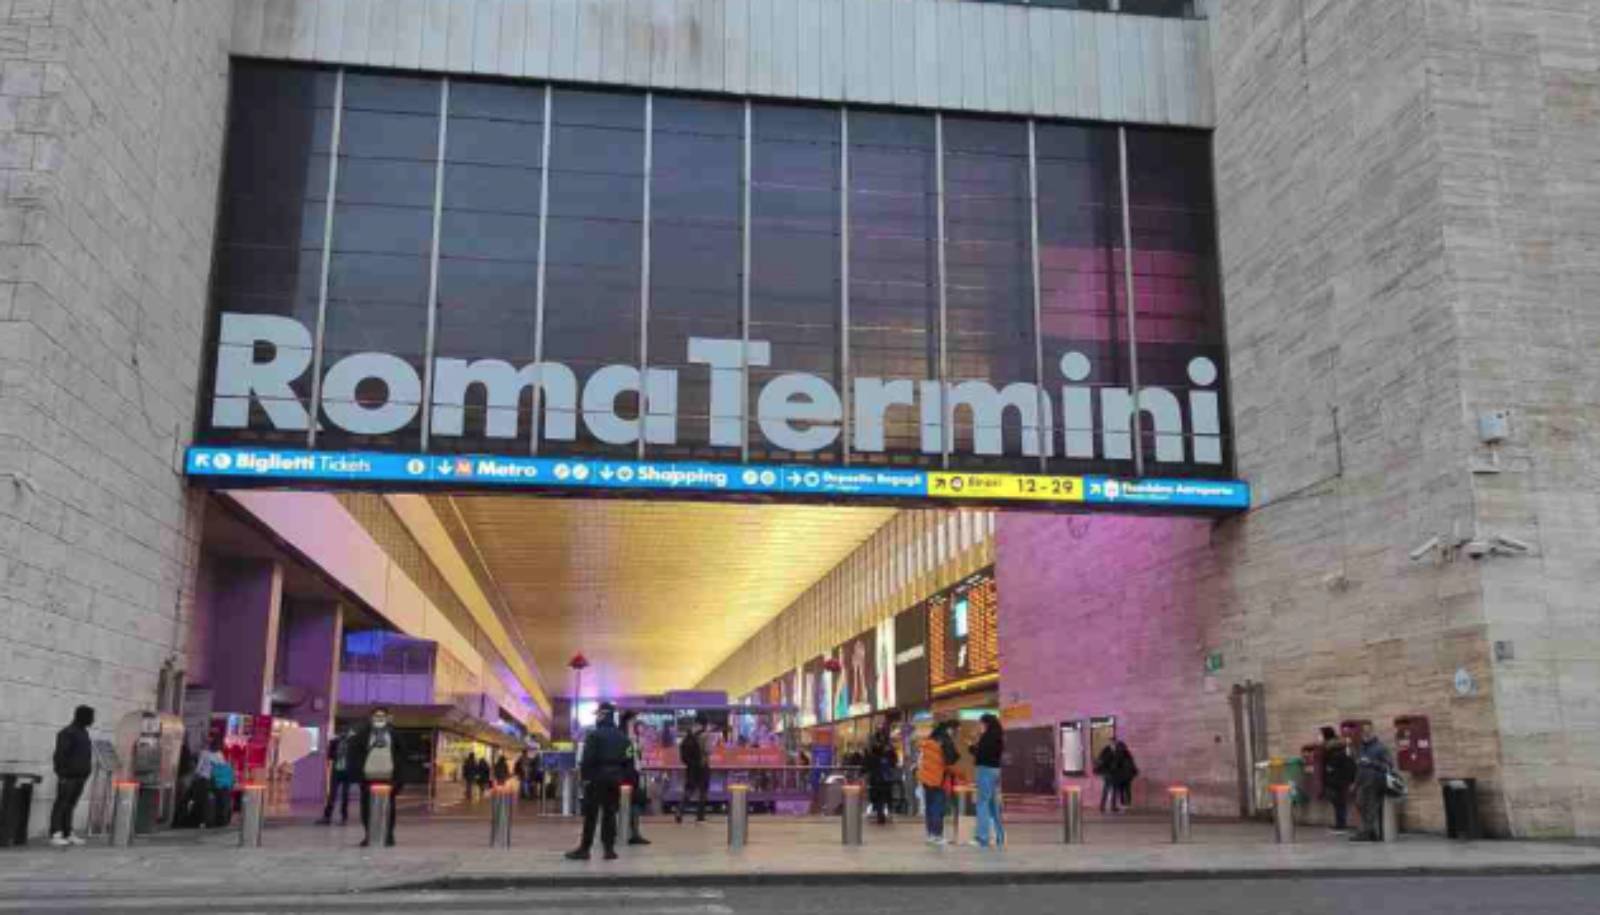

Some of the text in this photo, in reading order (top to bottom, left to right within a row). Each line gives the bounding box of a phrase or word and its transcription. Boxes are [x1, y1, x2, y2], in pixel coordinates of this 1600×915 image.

[235, 452, 371, 472] Biglietti Tickets
[478, 460, 537, 477] Metro
[637, 464, 727, 486] Shopping
